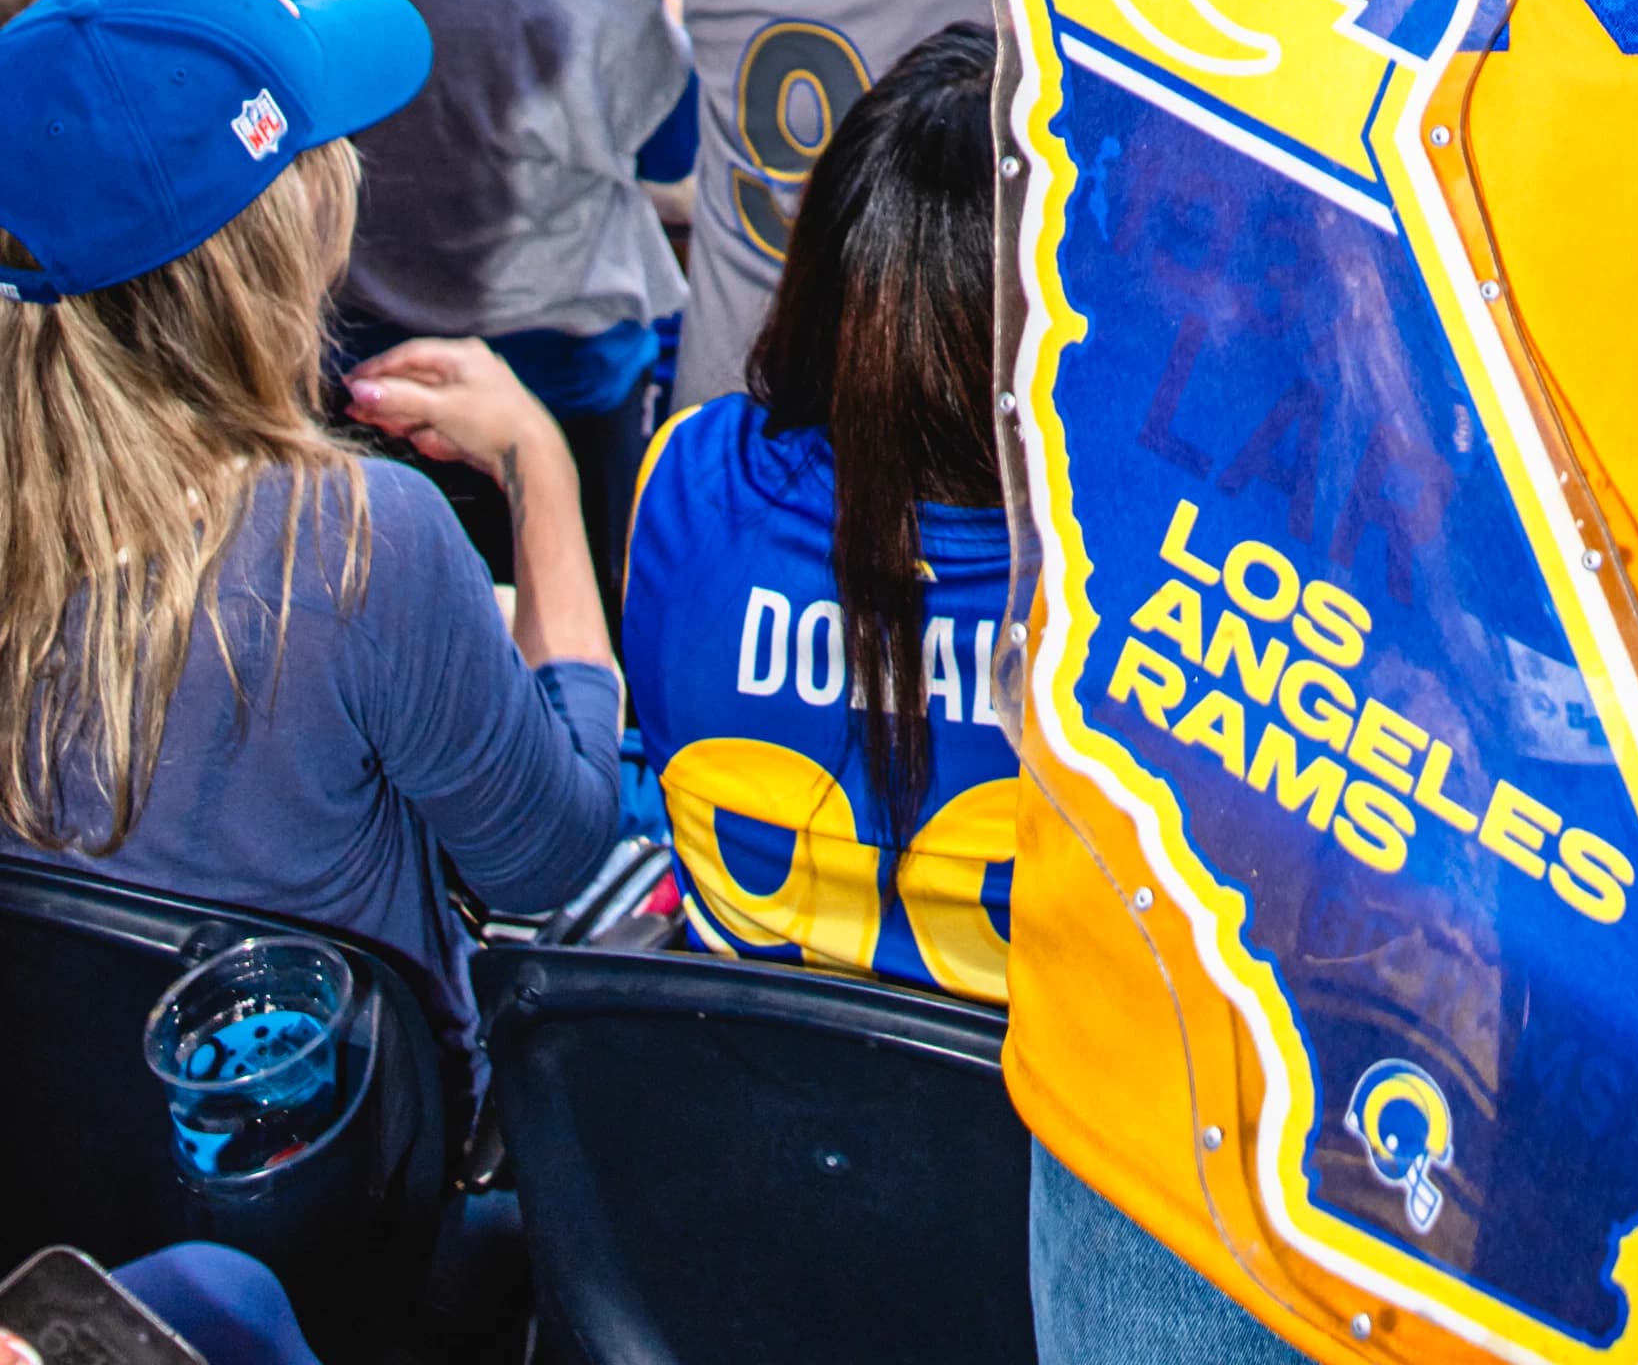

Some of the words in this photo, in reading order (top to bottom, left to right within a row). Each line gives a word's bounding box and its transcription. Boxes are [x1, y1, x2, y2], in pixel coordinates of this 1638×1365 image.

[1159, 497, 1373, 669] LOS
[1106, 636, 1416, 873] RAMS
[1129, 578, 1636, 924] ANGELES
